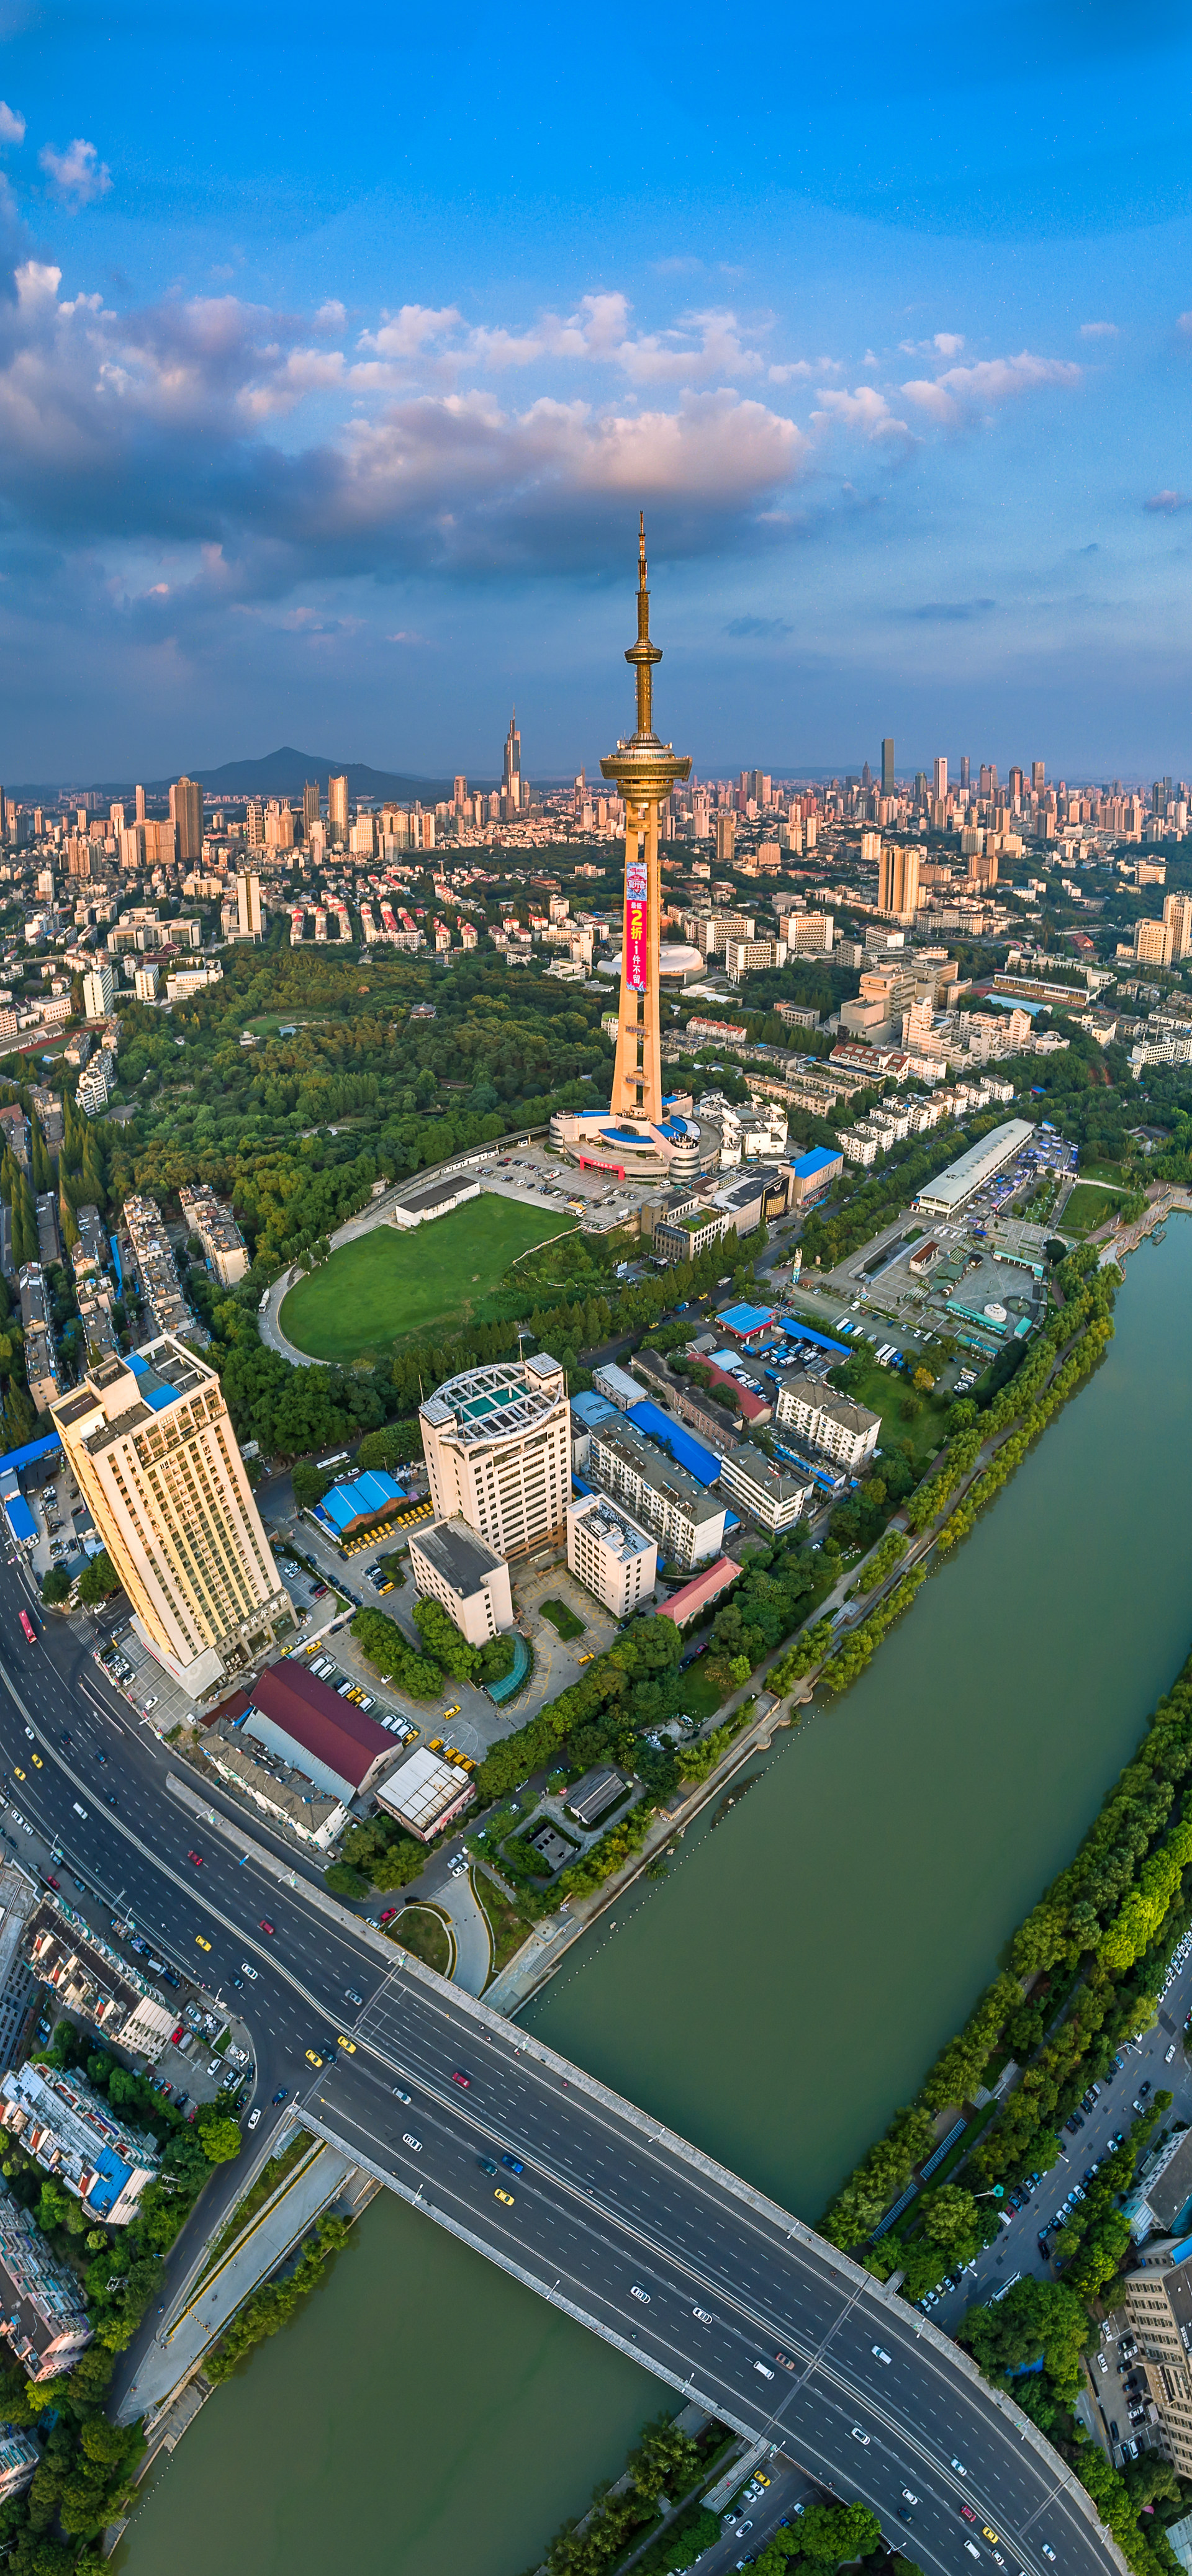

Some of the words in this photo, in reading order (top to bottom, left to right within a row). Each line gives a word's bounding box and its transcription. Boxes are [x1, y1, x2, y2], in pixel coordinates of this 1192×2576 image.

[240, 1593, 287, 1635] 美贝尔整形
